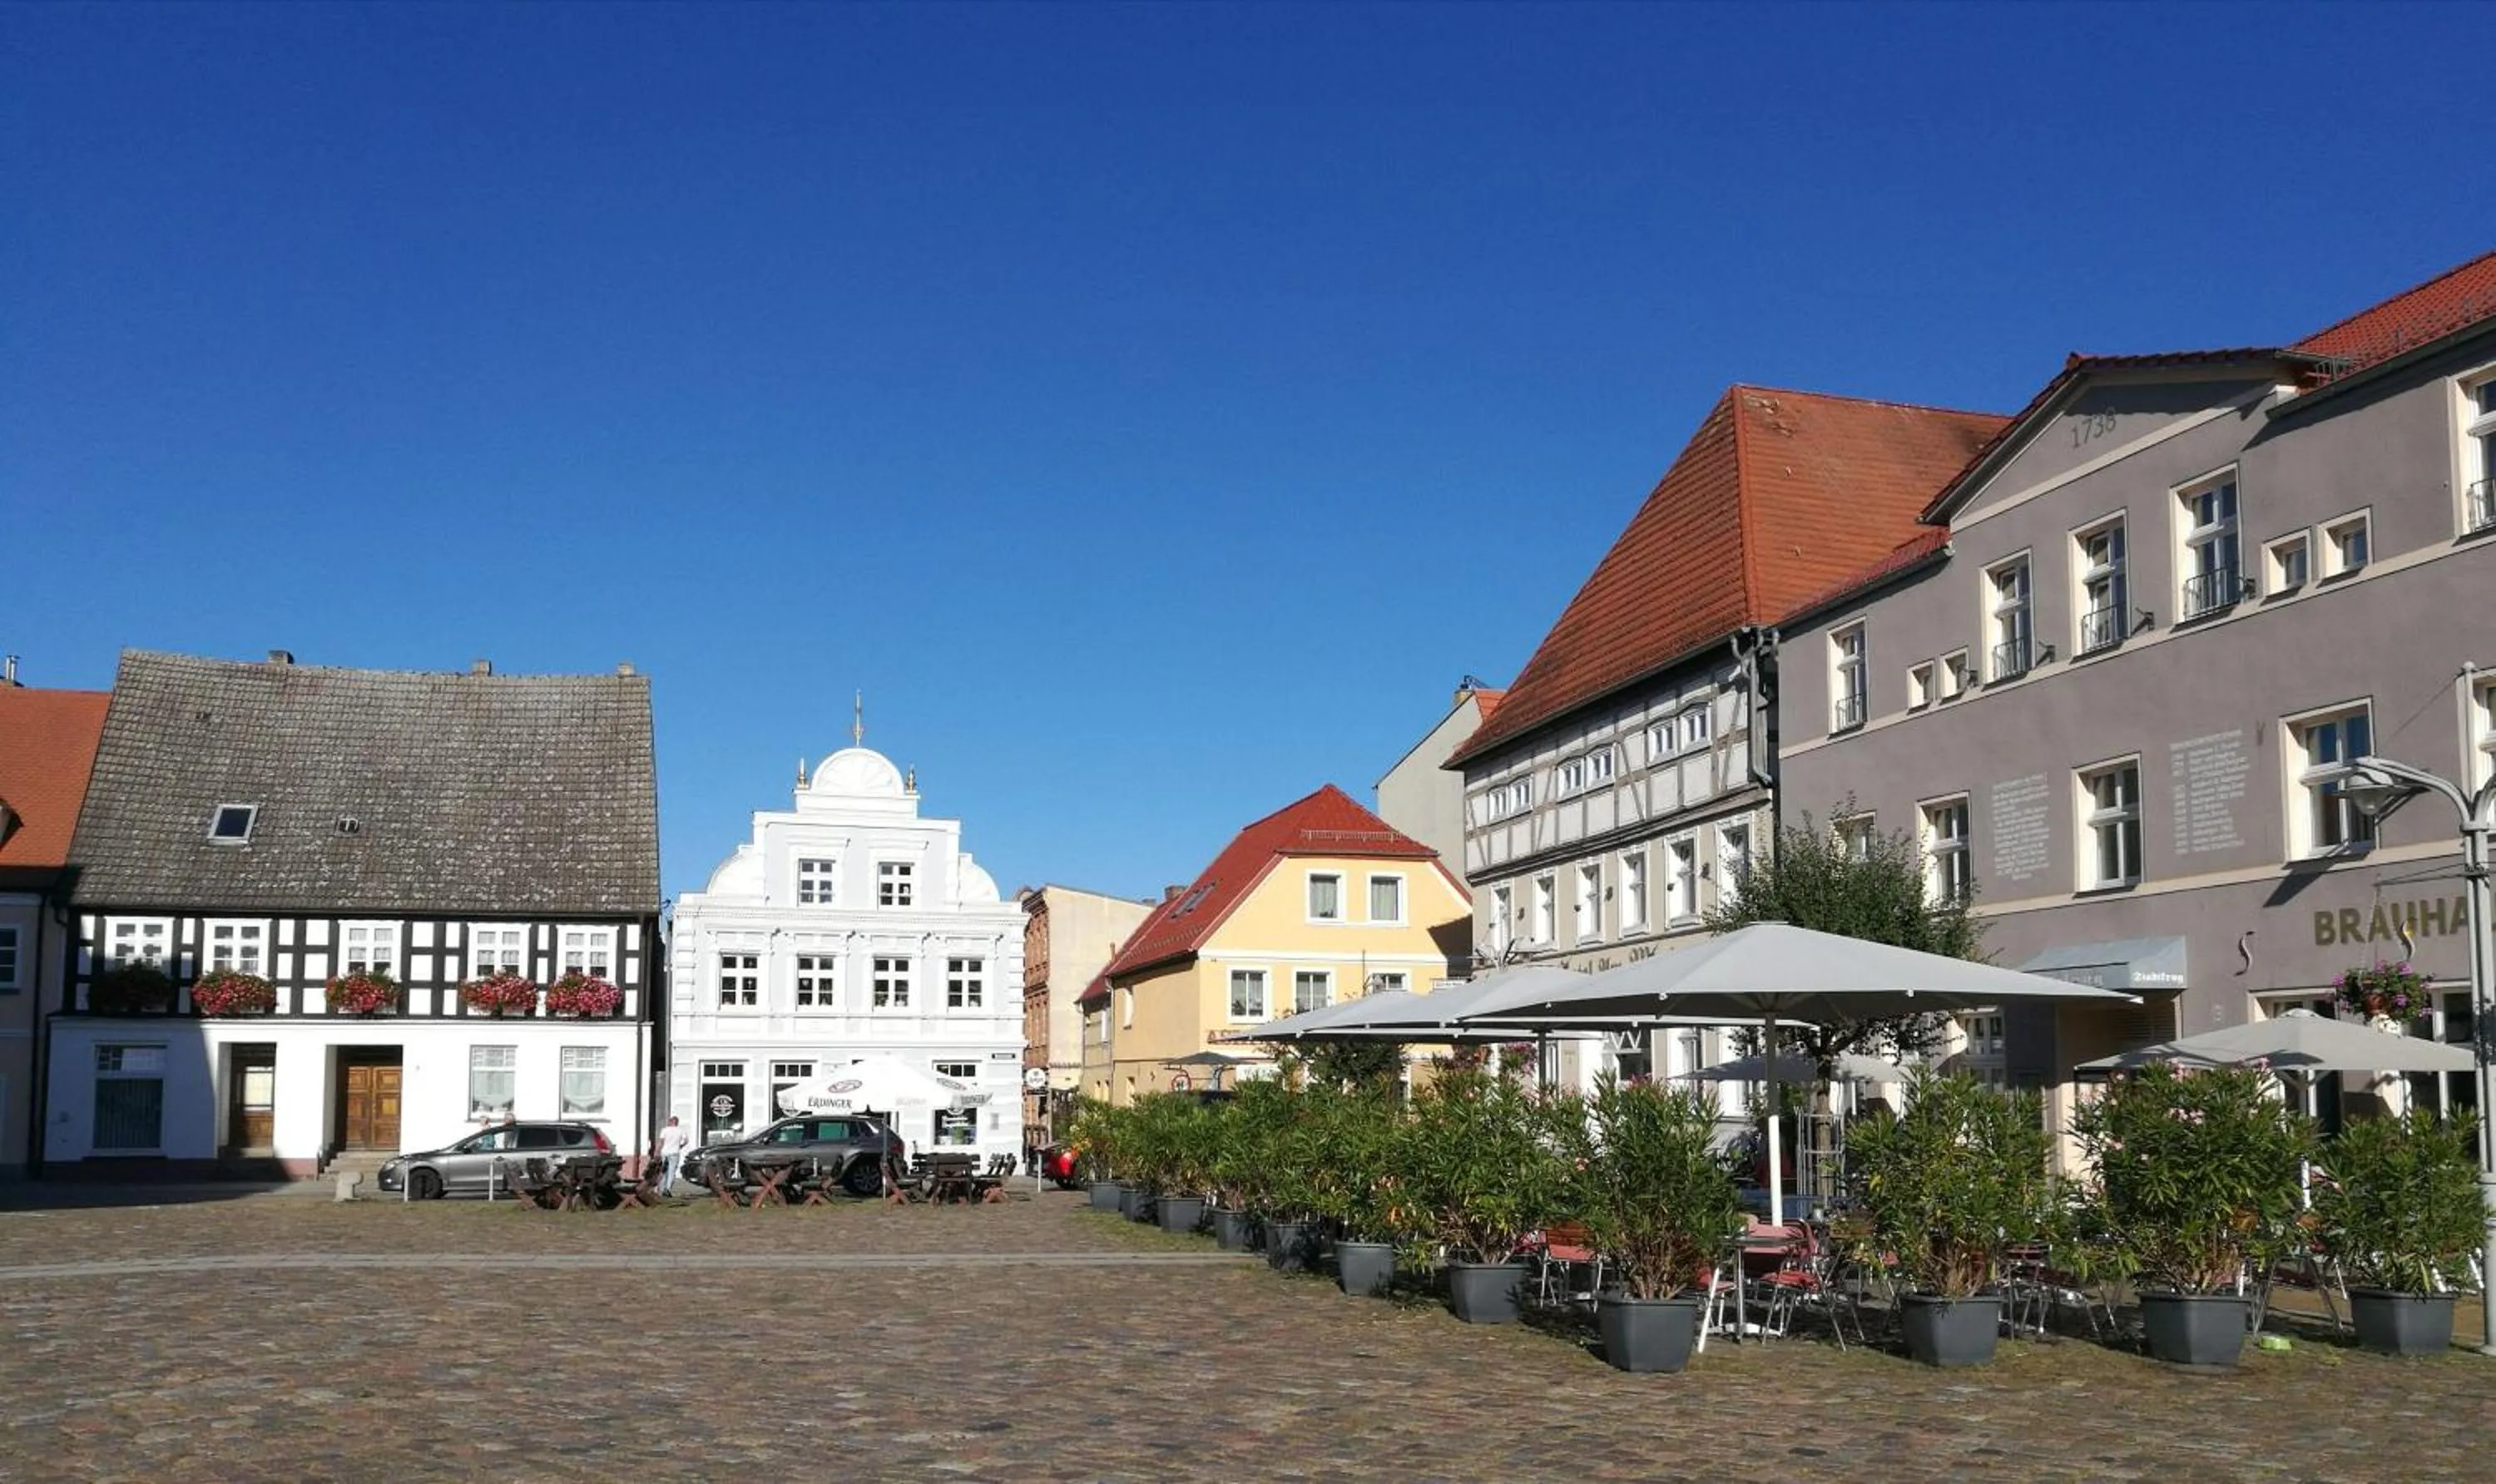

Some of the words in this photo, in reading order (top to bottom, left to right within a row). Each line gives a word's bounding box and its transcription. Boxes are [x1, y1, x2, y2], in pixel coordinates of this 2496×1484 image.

[2070, 407, 2117, 448] 1738
[2314, 896, 2469, 947] BRAUHA
[808, 1096, 852, 1108] ERDINGER
